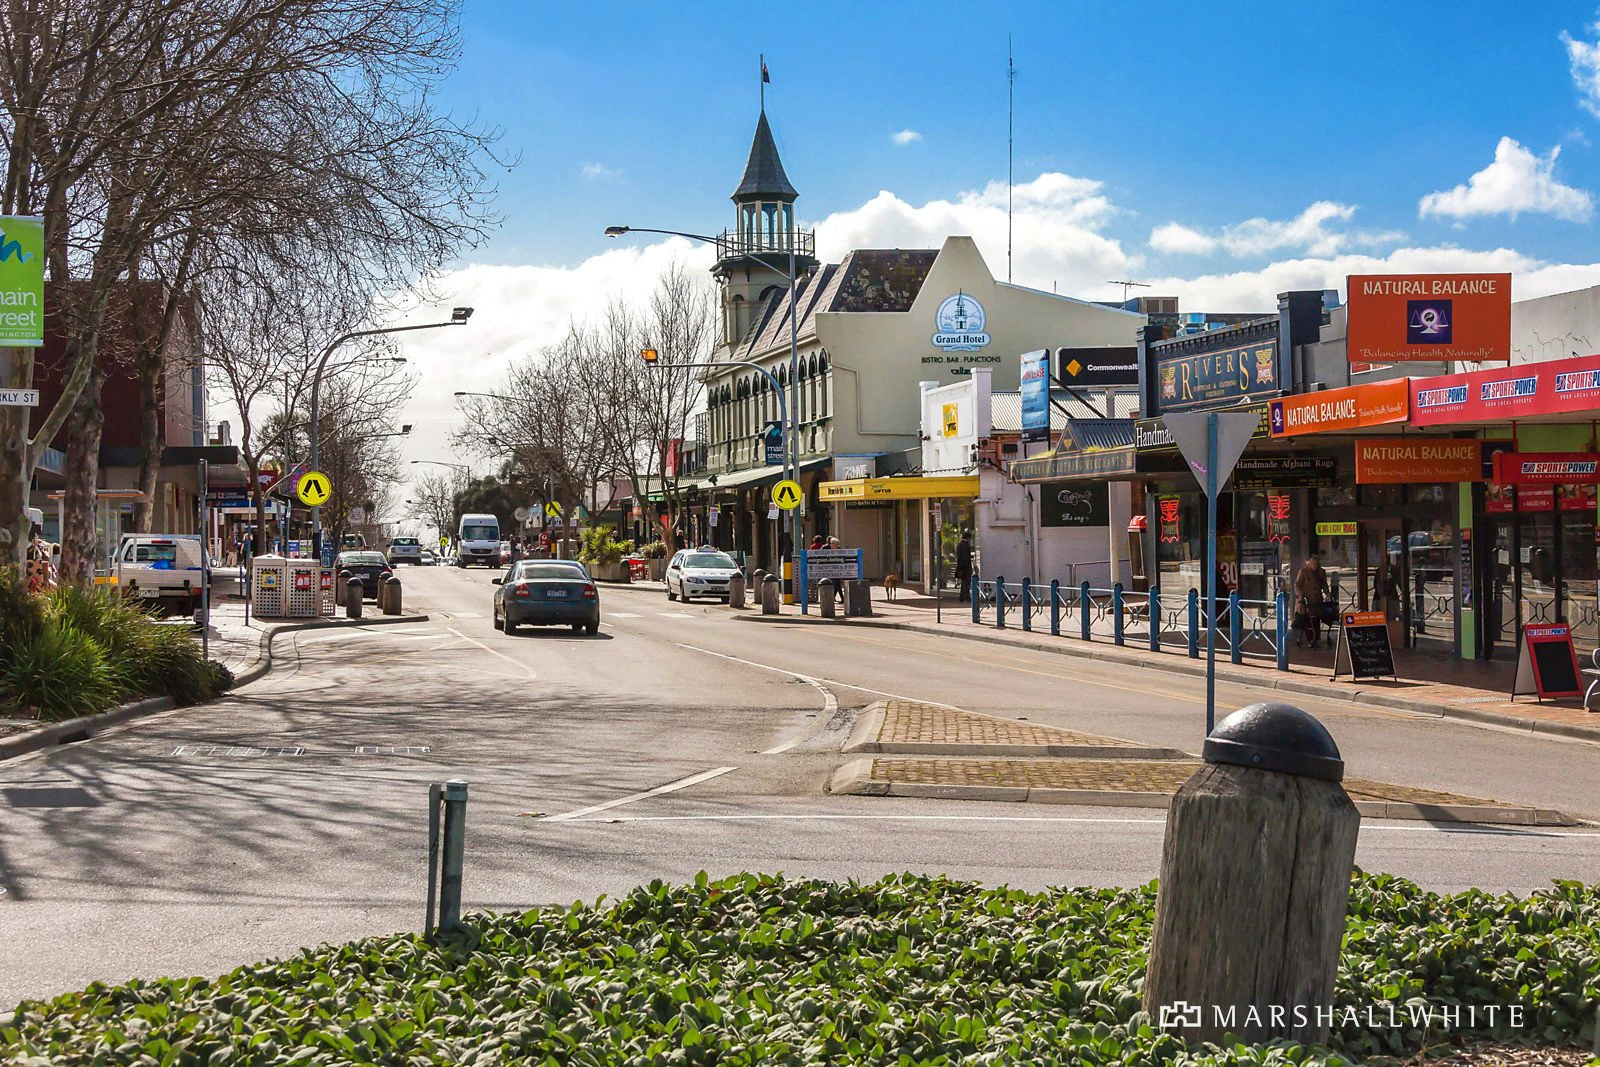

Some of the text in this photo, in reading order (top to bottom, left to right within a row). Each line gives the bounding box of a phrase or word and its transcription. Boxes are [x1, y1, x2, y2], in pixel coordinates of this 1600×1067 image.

[1363, 279, 1497, 295] NATURAL BALANCE
[0, 310, 37, 327] reet
[936, 334, 985, 344] Grand Hotel
[1412, 347, 1443, 357] Health
[921, 356, 944, 364] BISTRO
[963, 355, 1001, 363] FUNCTIONS
[1087, 363, 1138, 371] Commonwealt
[1180, 351, 1249, 400] RIVERS
[1490, 378, 1536, 398] SPORTSPOWER
[24, 393, 34, 402] ST
[1427, 386, 1467, 405] SPORTSPOWER
[1287, 404, 1320, 427] NATURAL
[1321, 399, 1356, 422] BALANCE
[1363, 446, 1475, 461] NATURAL BALANCE
[1237, 458, 1334, 469] Handmade Afghani Rugs
[1536, 462, 1595, 473] SPORTSPOWER
[1407, 467, 1433, 476] Health
